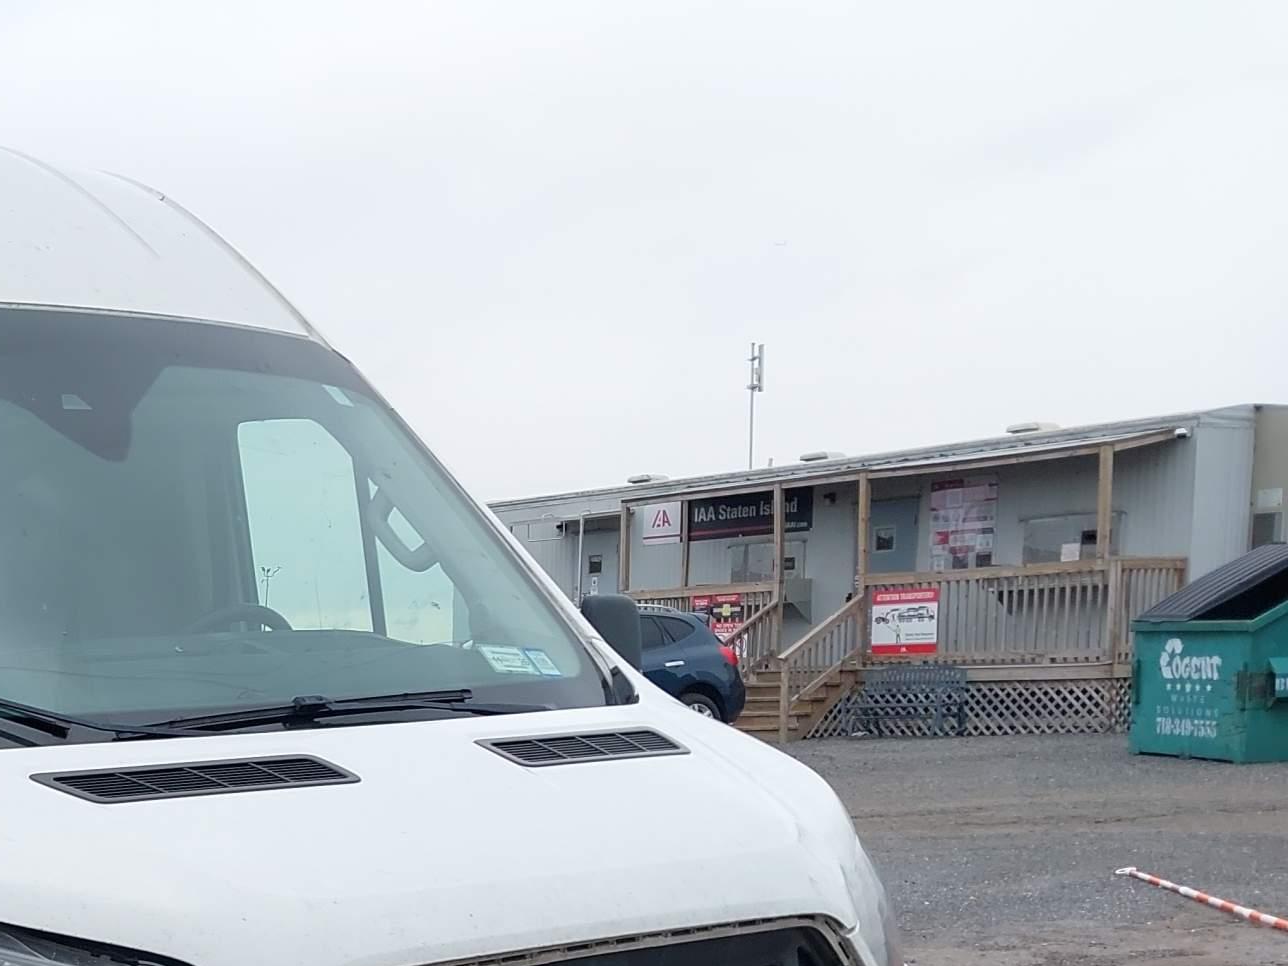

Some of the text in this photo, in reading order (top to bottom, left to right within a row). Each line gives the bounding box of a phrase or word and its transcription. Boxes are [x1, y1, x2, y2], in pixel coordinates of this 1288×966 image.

[694, 497, 798, 523] IAA Staten Islnd
